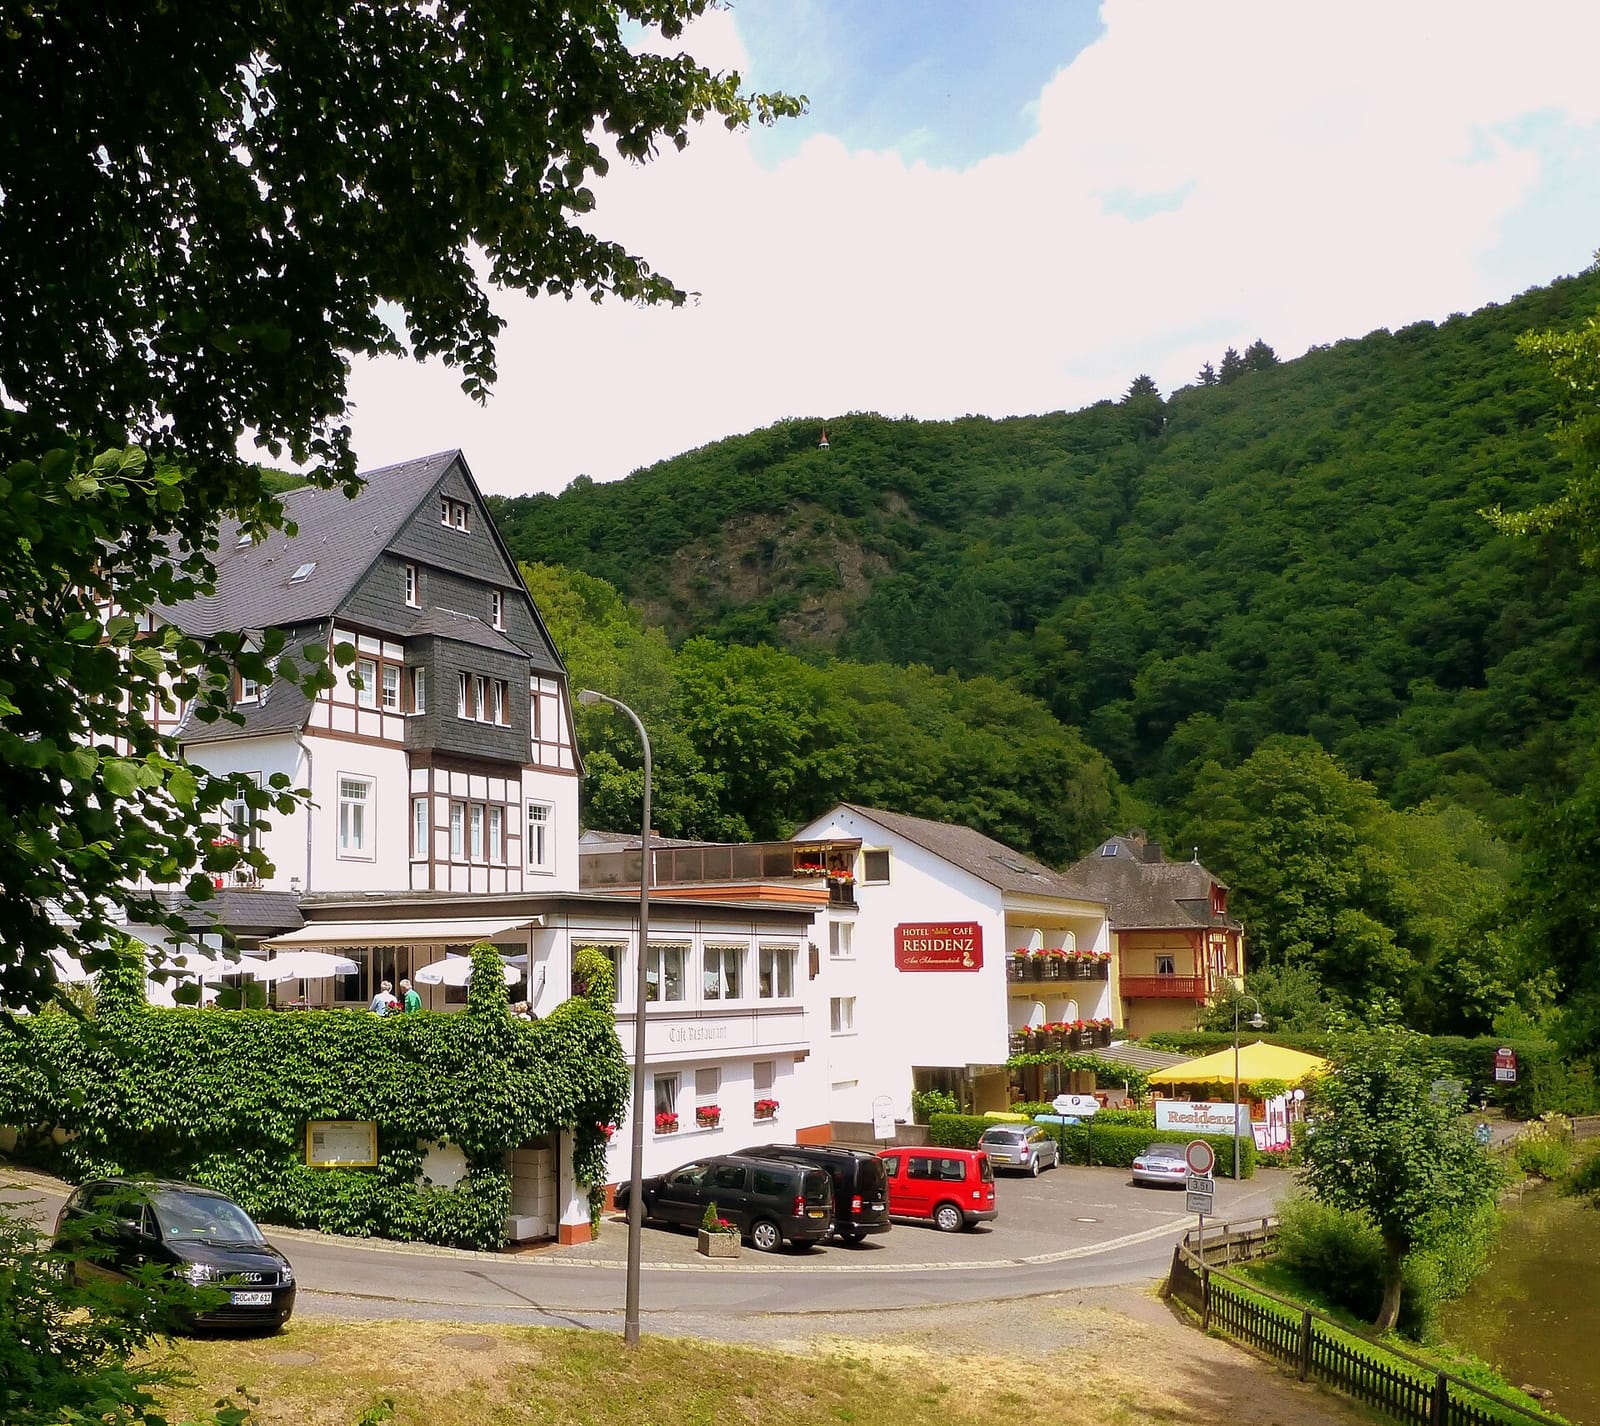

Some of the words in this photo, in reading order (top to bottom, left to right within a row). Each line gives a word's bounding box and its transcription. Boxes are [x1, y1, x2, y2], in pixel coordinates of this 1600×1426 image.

[902, 928, 929, 936] HOTEL
[953, 926, 974, 935] CAFÉ
[903, 939, 974, 952] RESIDENZ
[1168, 1111, 1236, 1125] Residenz
